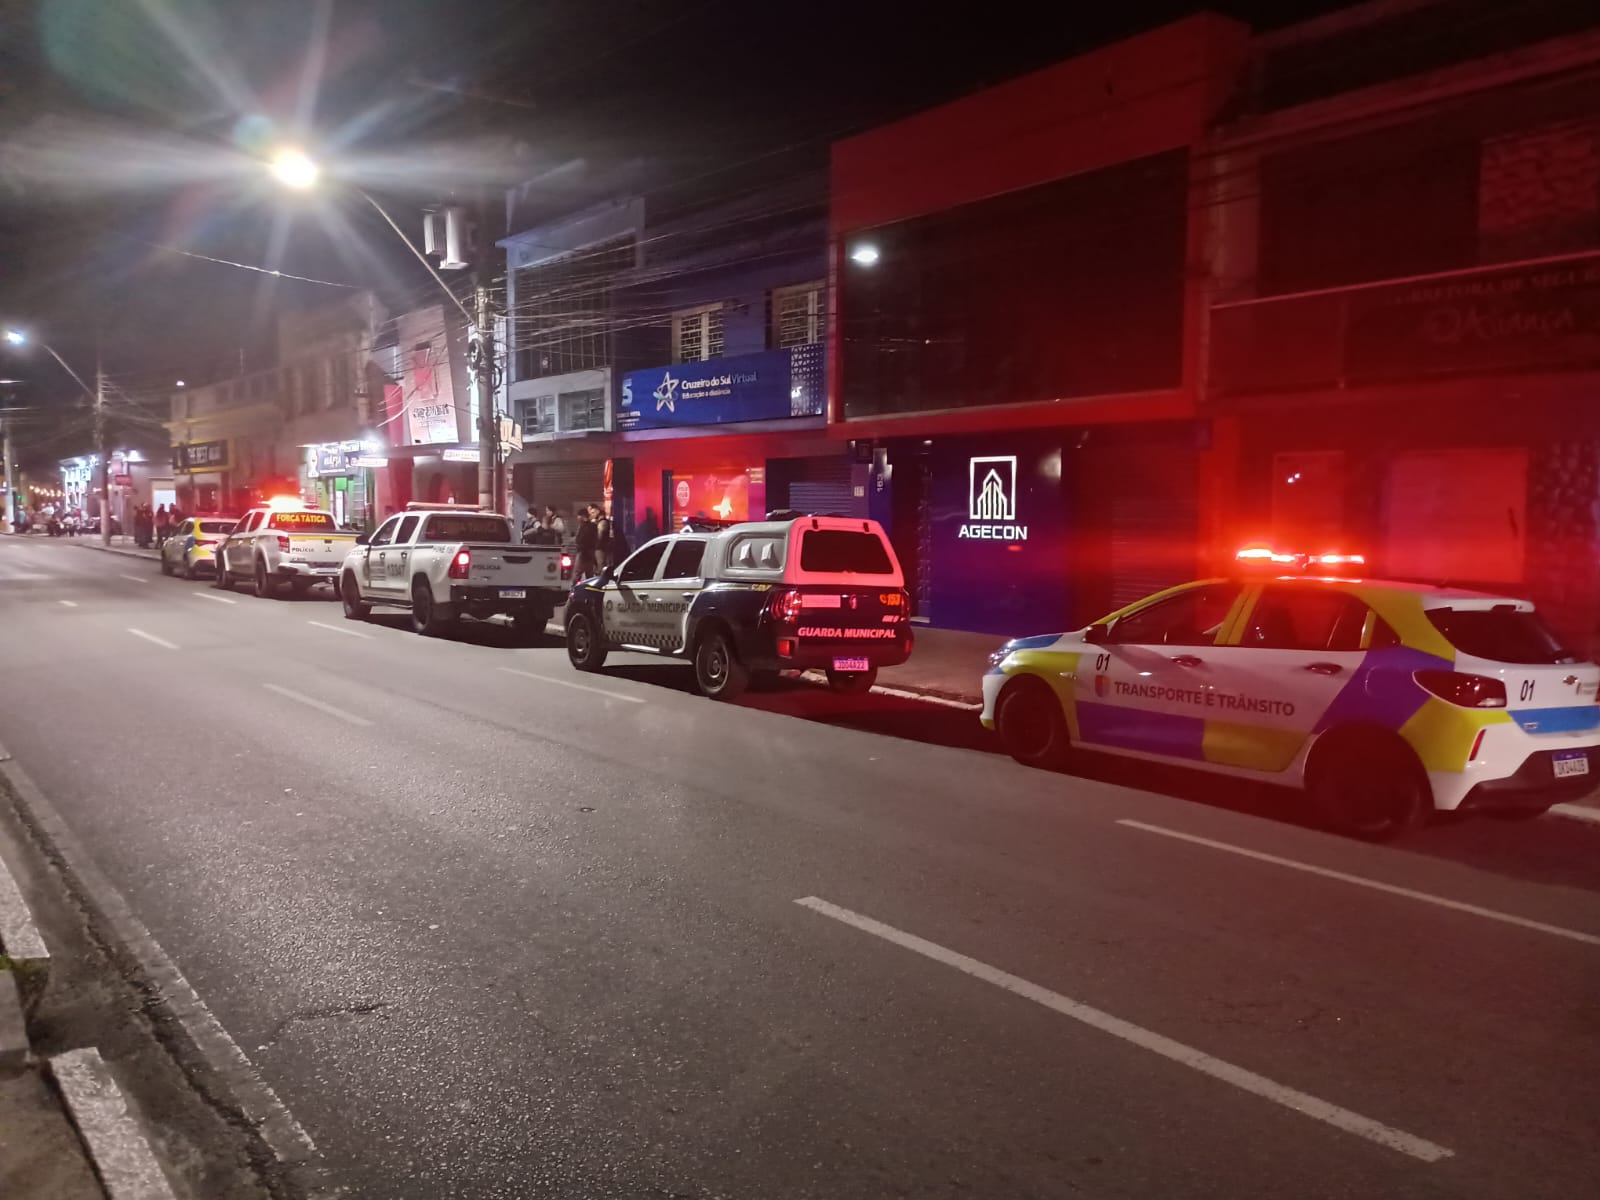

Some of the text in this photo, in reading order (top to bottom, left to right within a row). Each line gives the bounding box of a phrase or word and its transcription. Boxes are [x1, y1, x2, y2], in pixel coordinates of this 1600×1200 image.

[681, 371, 757, 390] Cruzeiro do Sul Virtual
[276, 514, 327, 523] FORÇA TÁTICA
[958, 524, 1028, 540] AGECON
[798, 627, 896, 639] GUARDA MUNICIPAL
[1095, 653, 1111, 671] 01
[1114, 680, 1296, 717] TRANSPORTE E TRÂNSITO
[1520, 679, 1535, 701] 01
